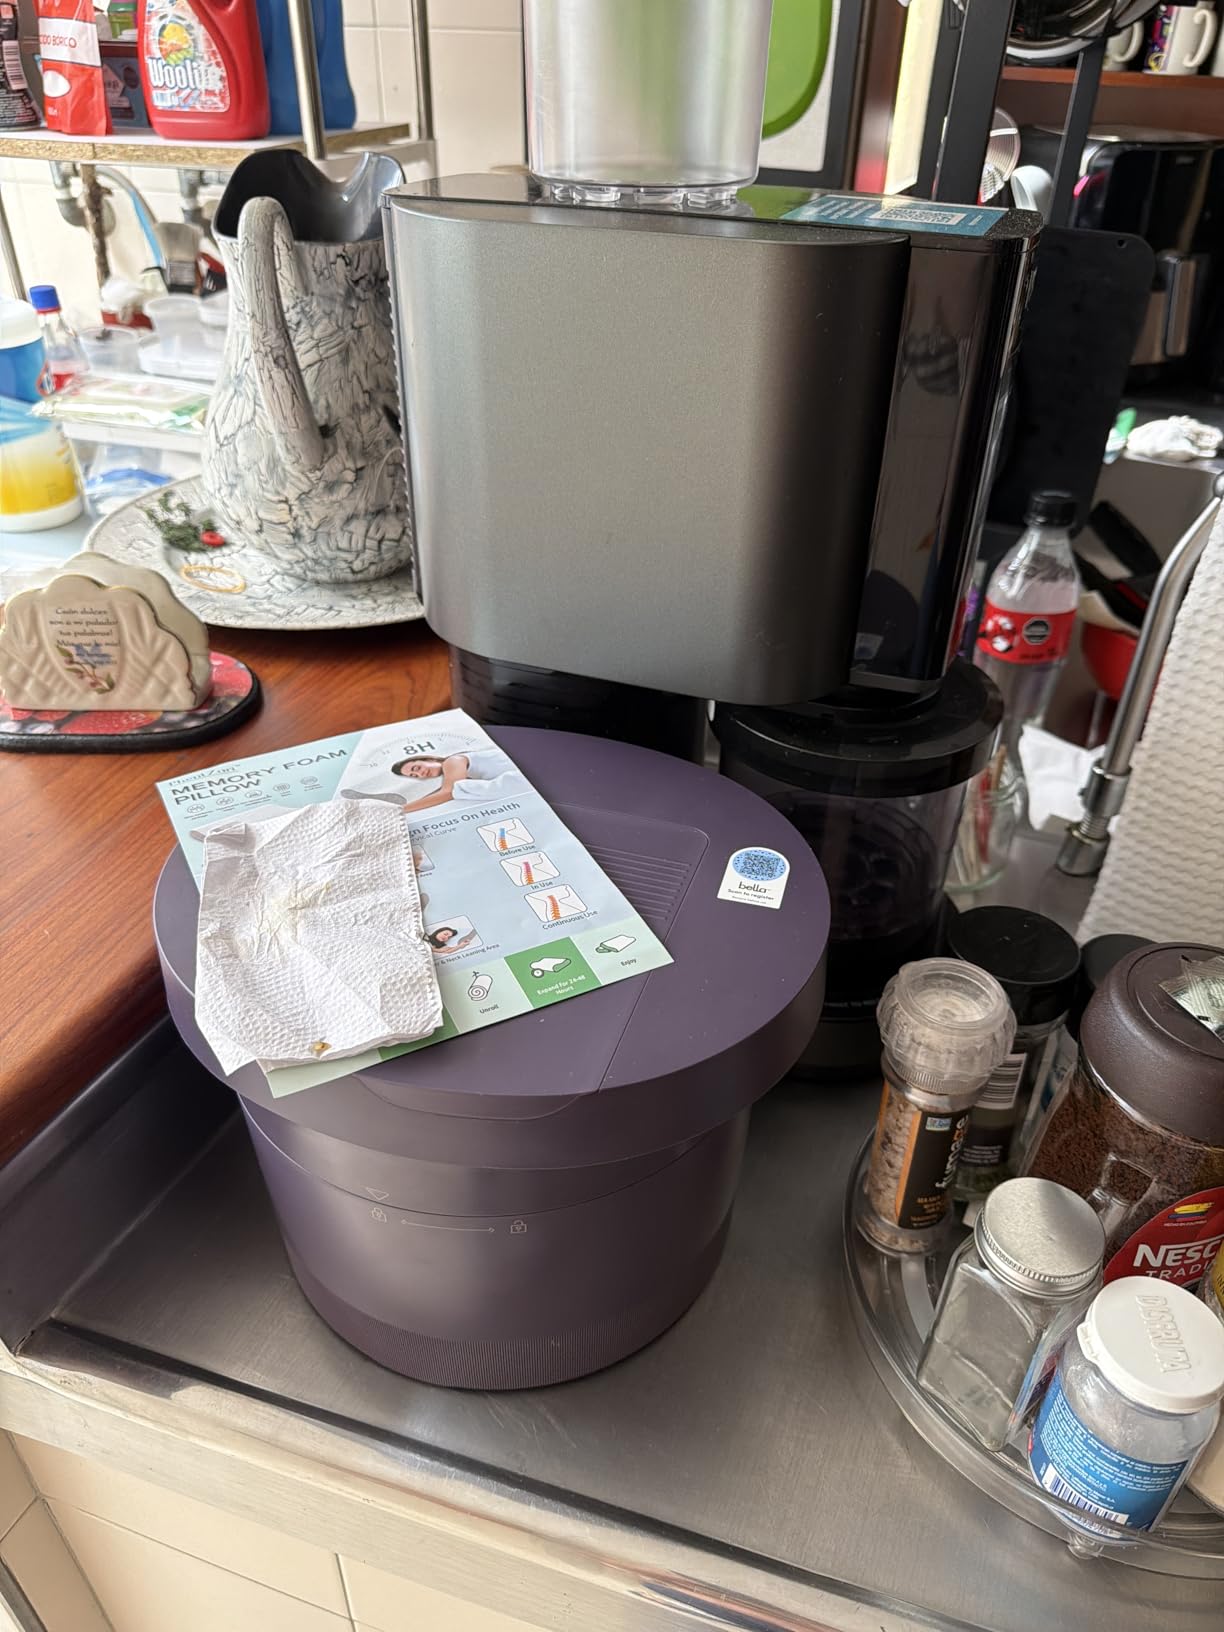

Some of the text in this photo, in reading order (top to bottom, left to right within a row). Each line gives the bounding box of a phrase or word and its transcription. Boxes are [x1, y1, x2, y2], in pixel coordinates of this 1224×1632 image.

[147, 57, 208, 90] Wooli
[403, 741, 435, 755] 8H
[171, 766, 277, 796] MEMORY
[282, 749, 347, 770] FOAM
[174, 779, 263, 805] PILLOW
[422, 802, 521, 832] Focus On Health
[411, 833, 433, 842] rvical
[434, 827, 457, 836] Curve
[499, 847, 522, 857] Before
[540, 880, 553, 888] Use
[738, 881, 767, 893] bella
[542, 910, 598, 930] Continuous Use
[620, 958, 637, 967] Enjoy
[537, 983, 559, 995] Expand
[559, 980, 569, 988] for
[480, 1004, 499, 1014] Unroll
[1133, 1237, 1222, 1267] NESC
[1146, 1260, 1210, 1279] TRADI
[1135, 1295, 1192, 1373] DISFRUTA
